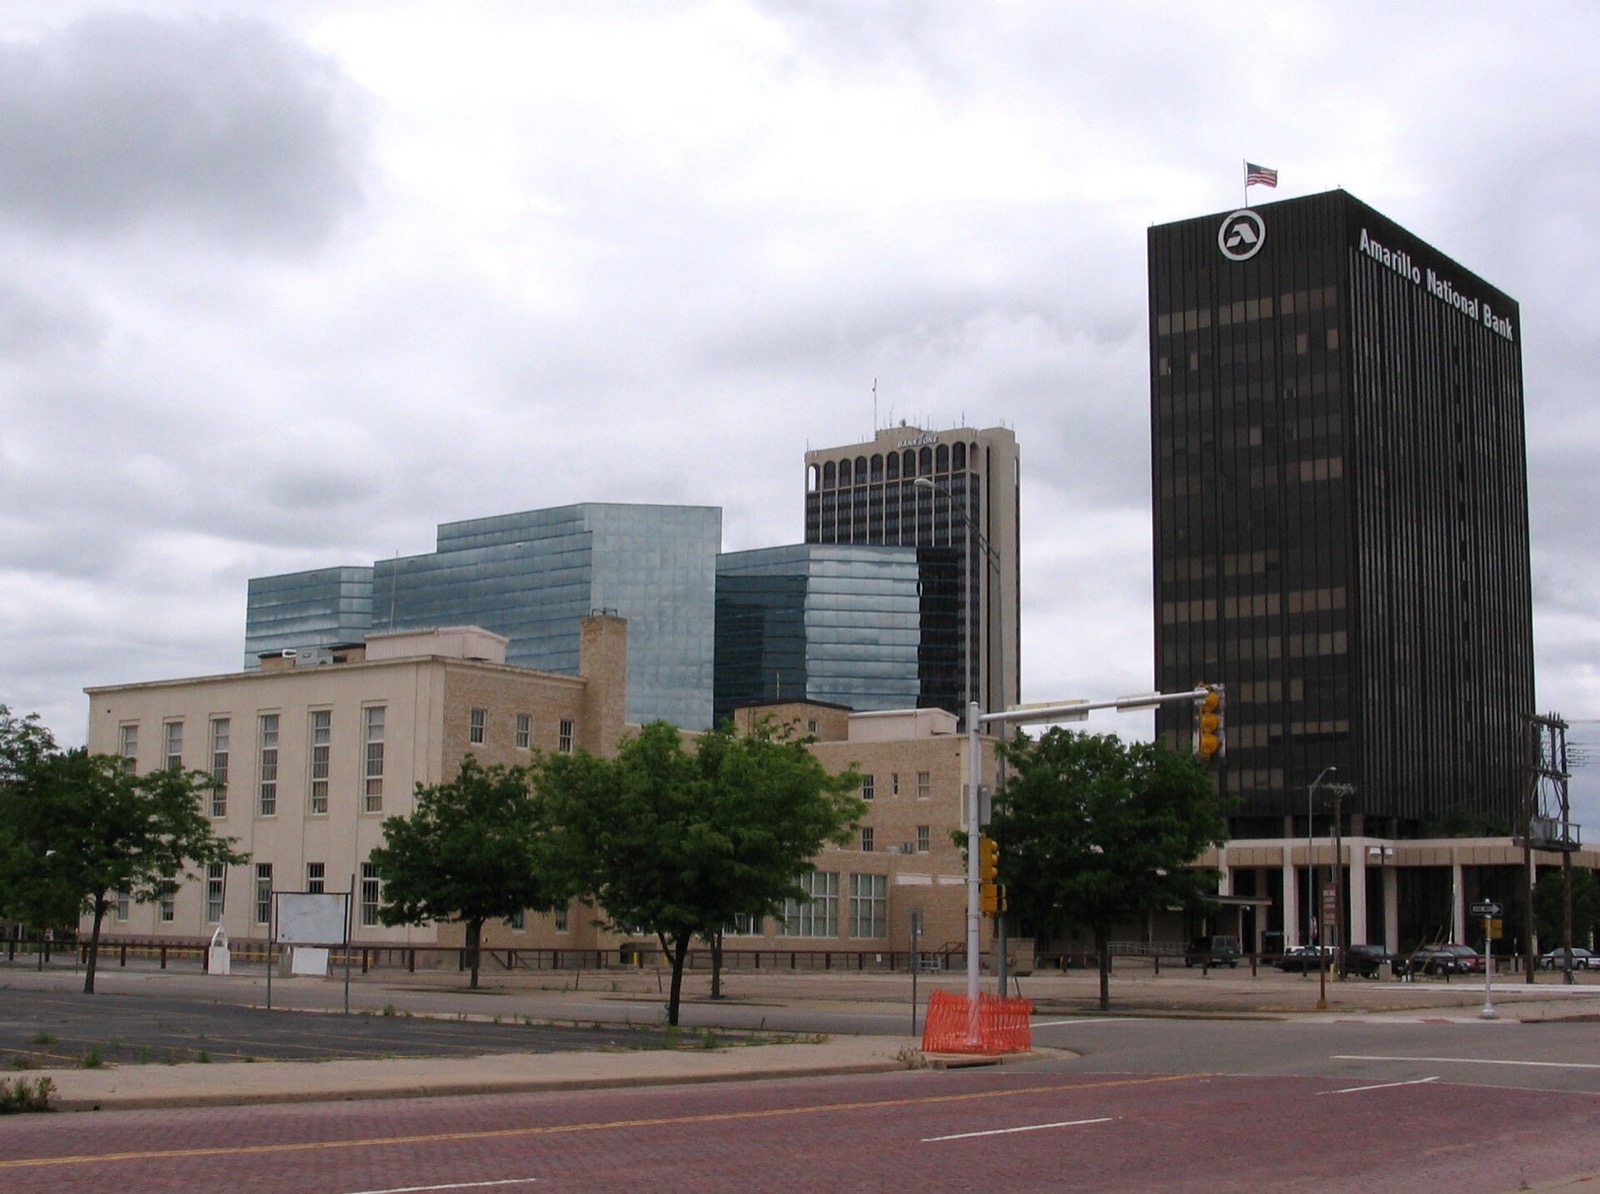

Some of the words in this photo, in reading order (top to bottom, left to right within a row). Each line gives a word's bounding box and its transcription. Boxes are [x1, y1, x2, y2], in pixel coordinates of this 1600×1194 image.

[1359, 228, 1421, 285] Amarillo
[1426, 268, 1479, 321] National
[1483, 303, 1514, 342] Bank
